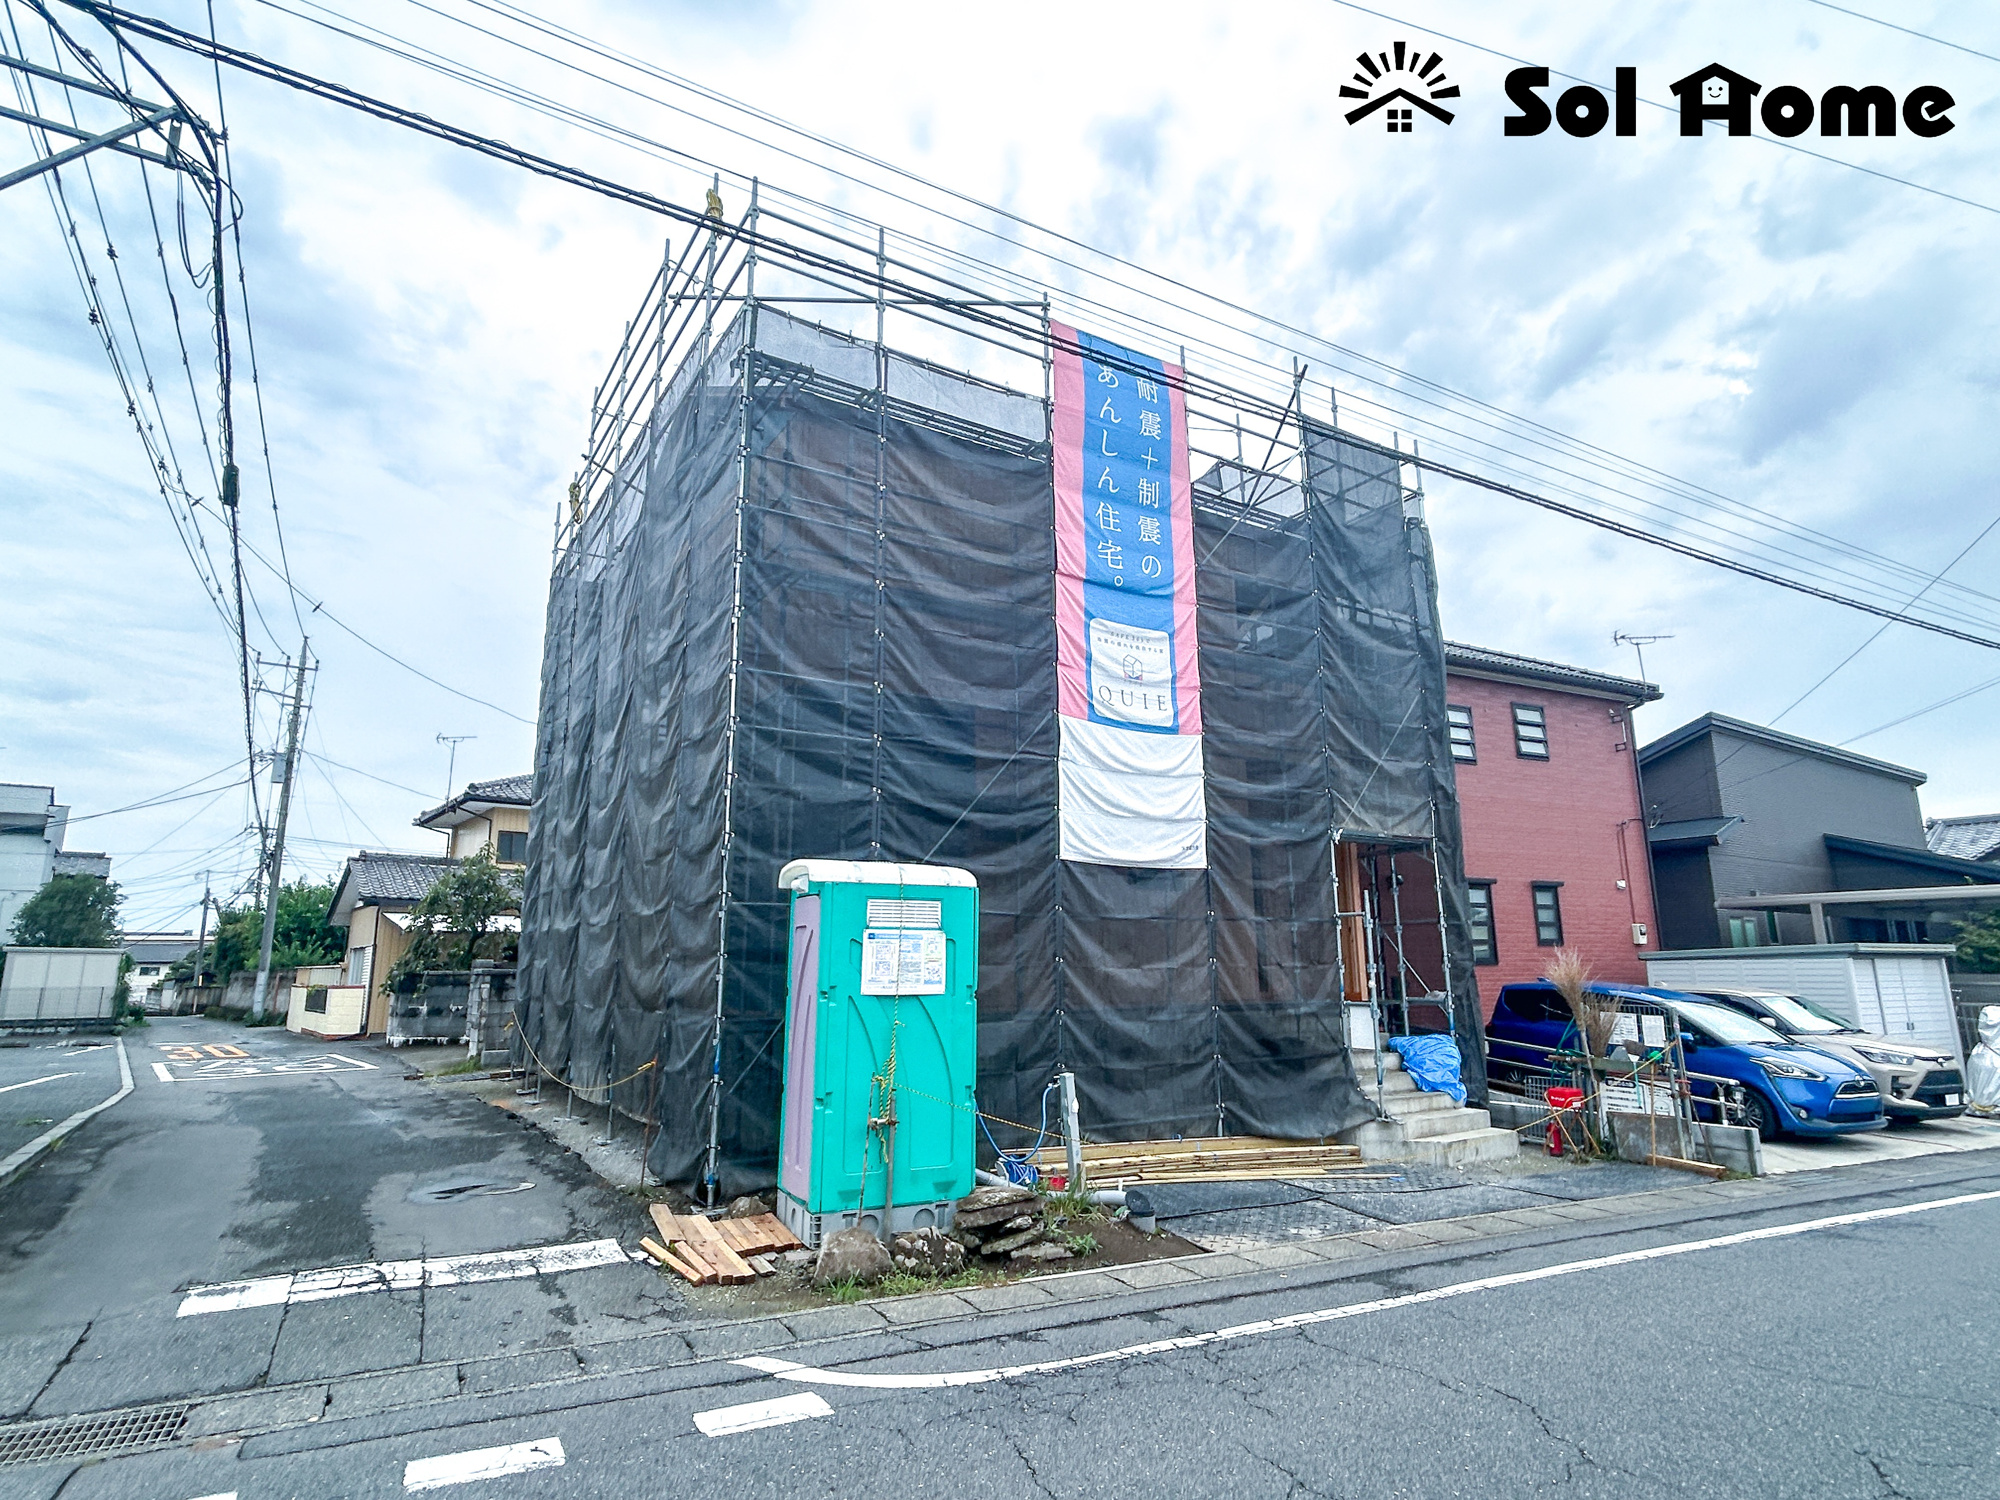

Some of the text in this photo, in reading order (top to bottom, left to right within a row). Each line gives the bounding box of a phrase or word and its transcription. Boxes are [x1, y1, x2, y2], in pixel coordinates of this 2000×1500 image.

[1095, 364, 1124, 587] あんしん住宅。
[1098, 685, 1168, 711] QUIE
[160, 1044, 250, 1060] 30
